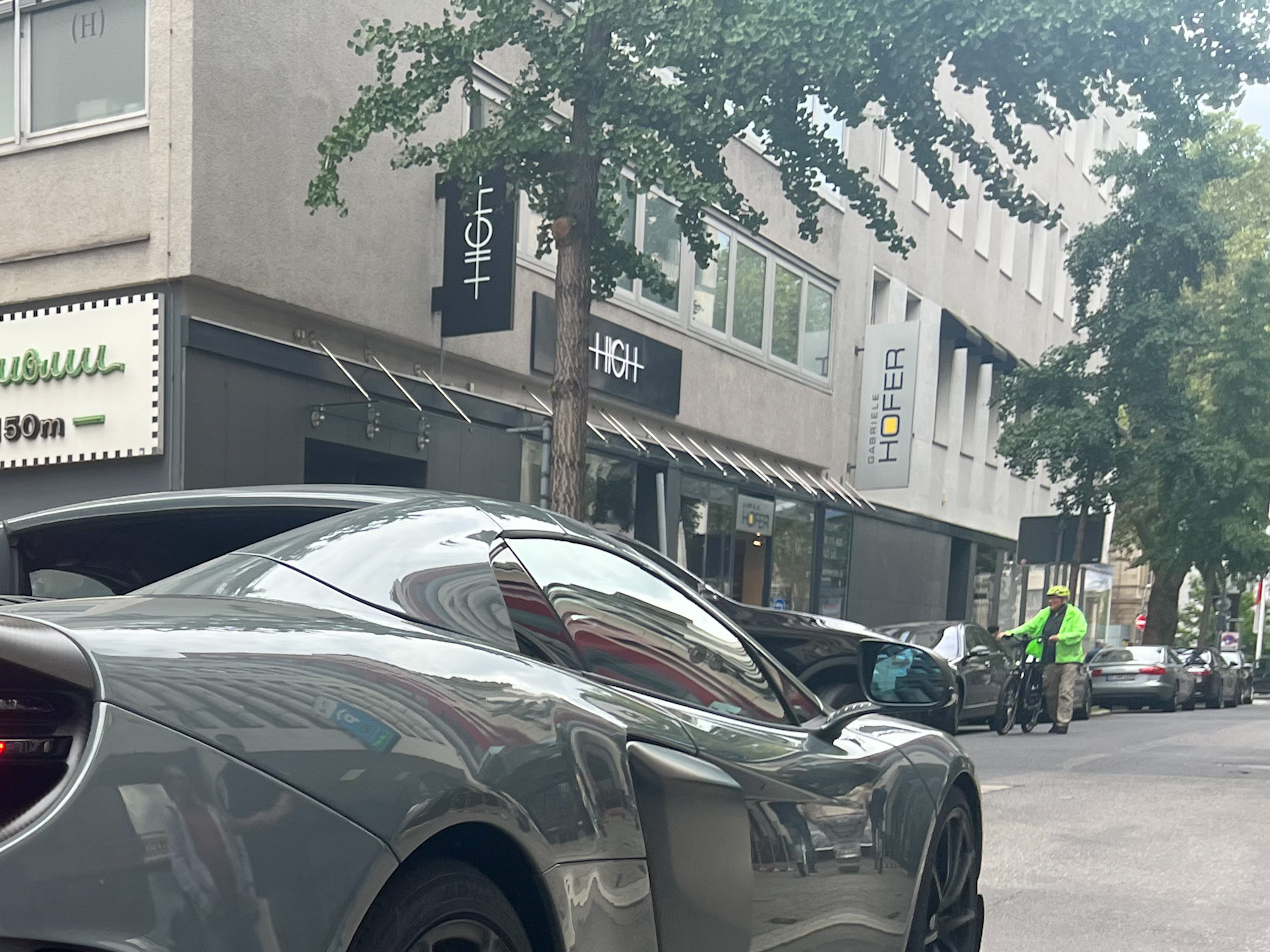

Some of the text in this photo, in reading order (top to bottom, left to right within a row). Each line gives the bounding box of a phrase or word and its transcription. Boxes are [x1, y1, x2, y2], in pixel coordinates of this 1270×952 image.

[71, 7, 105, 44] (H)
[588, 332, 645, 383] HIGH
[868, 393, 880, 464] GABRIELE
[878, 347, 905, 463] HOFER
